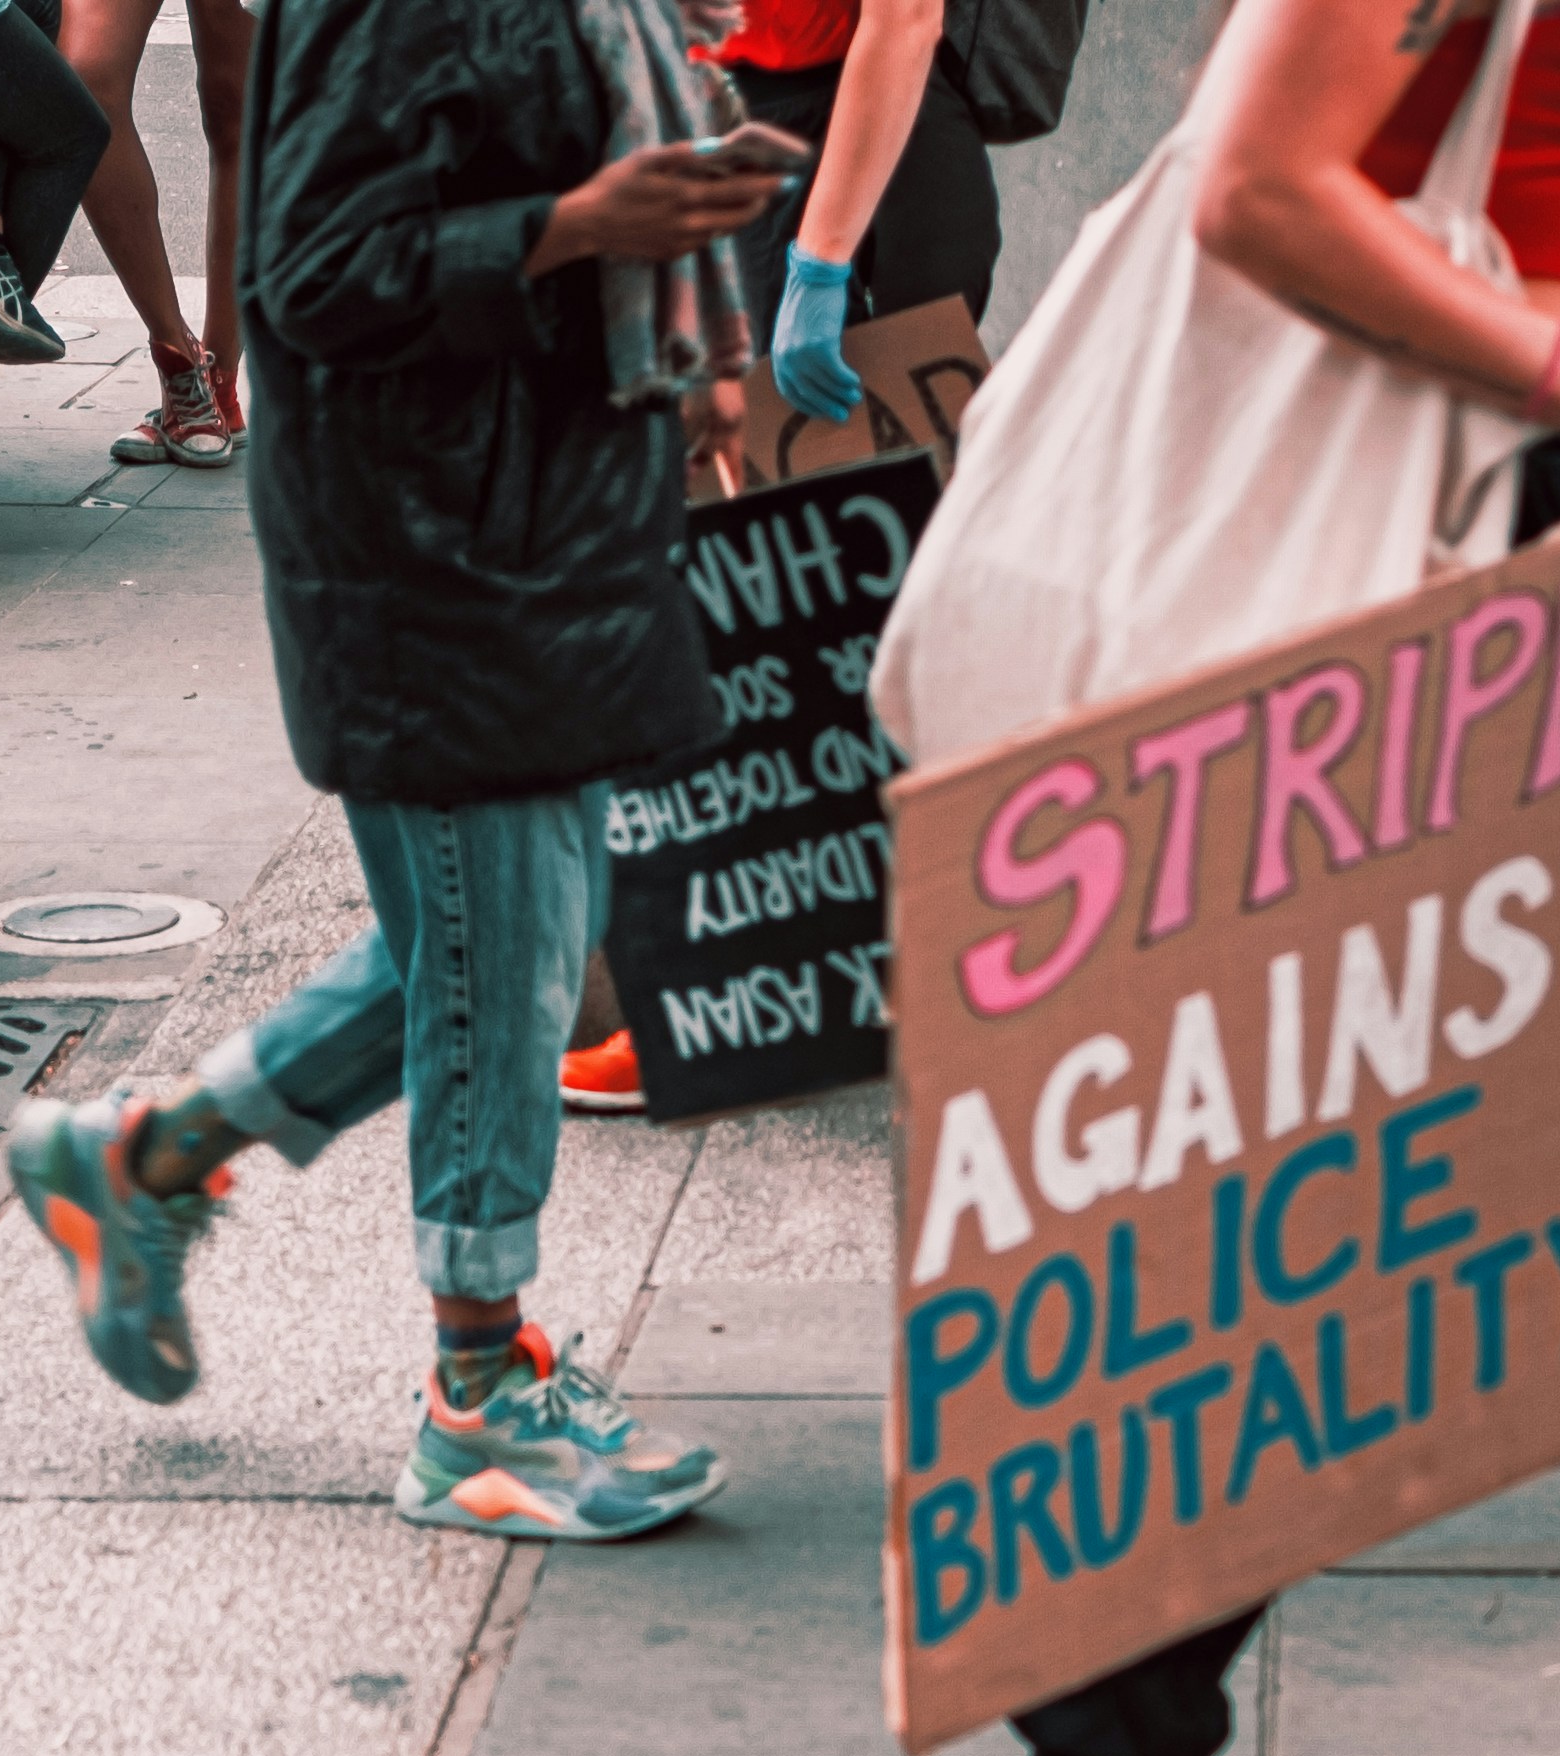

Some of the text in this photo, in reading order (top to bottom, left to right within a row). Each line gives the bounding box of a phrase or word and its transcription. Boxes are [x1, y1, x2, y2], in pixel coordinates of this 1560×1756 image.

[605, 749, 816, 854] TOGETHER
[662, 962, 821, 1060] ASIAN
[905, 1084, 1481, 1471] POLICE
